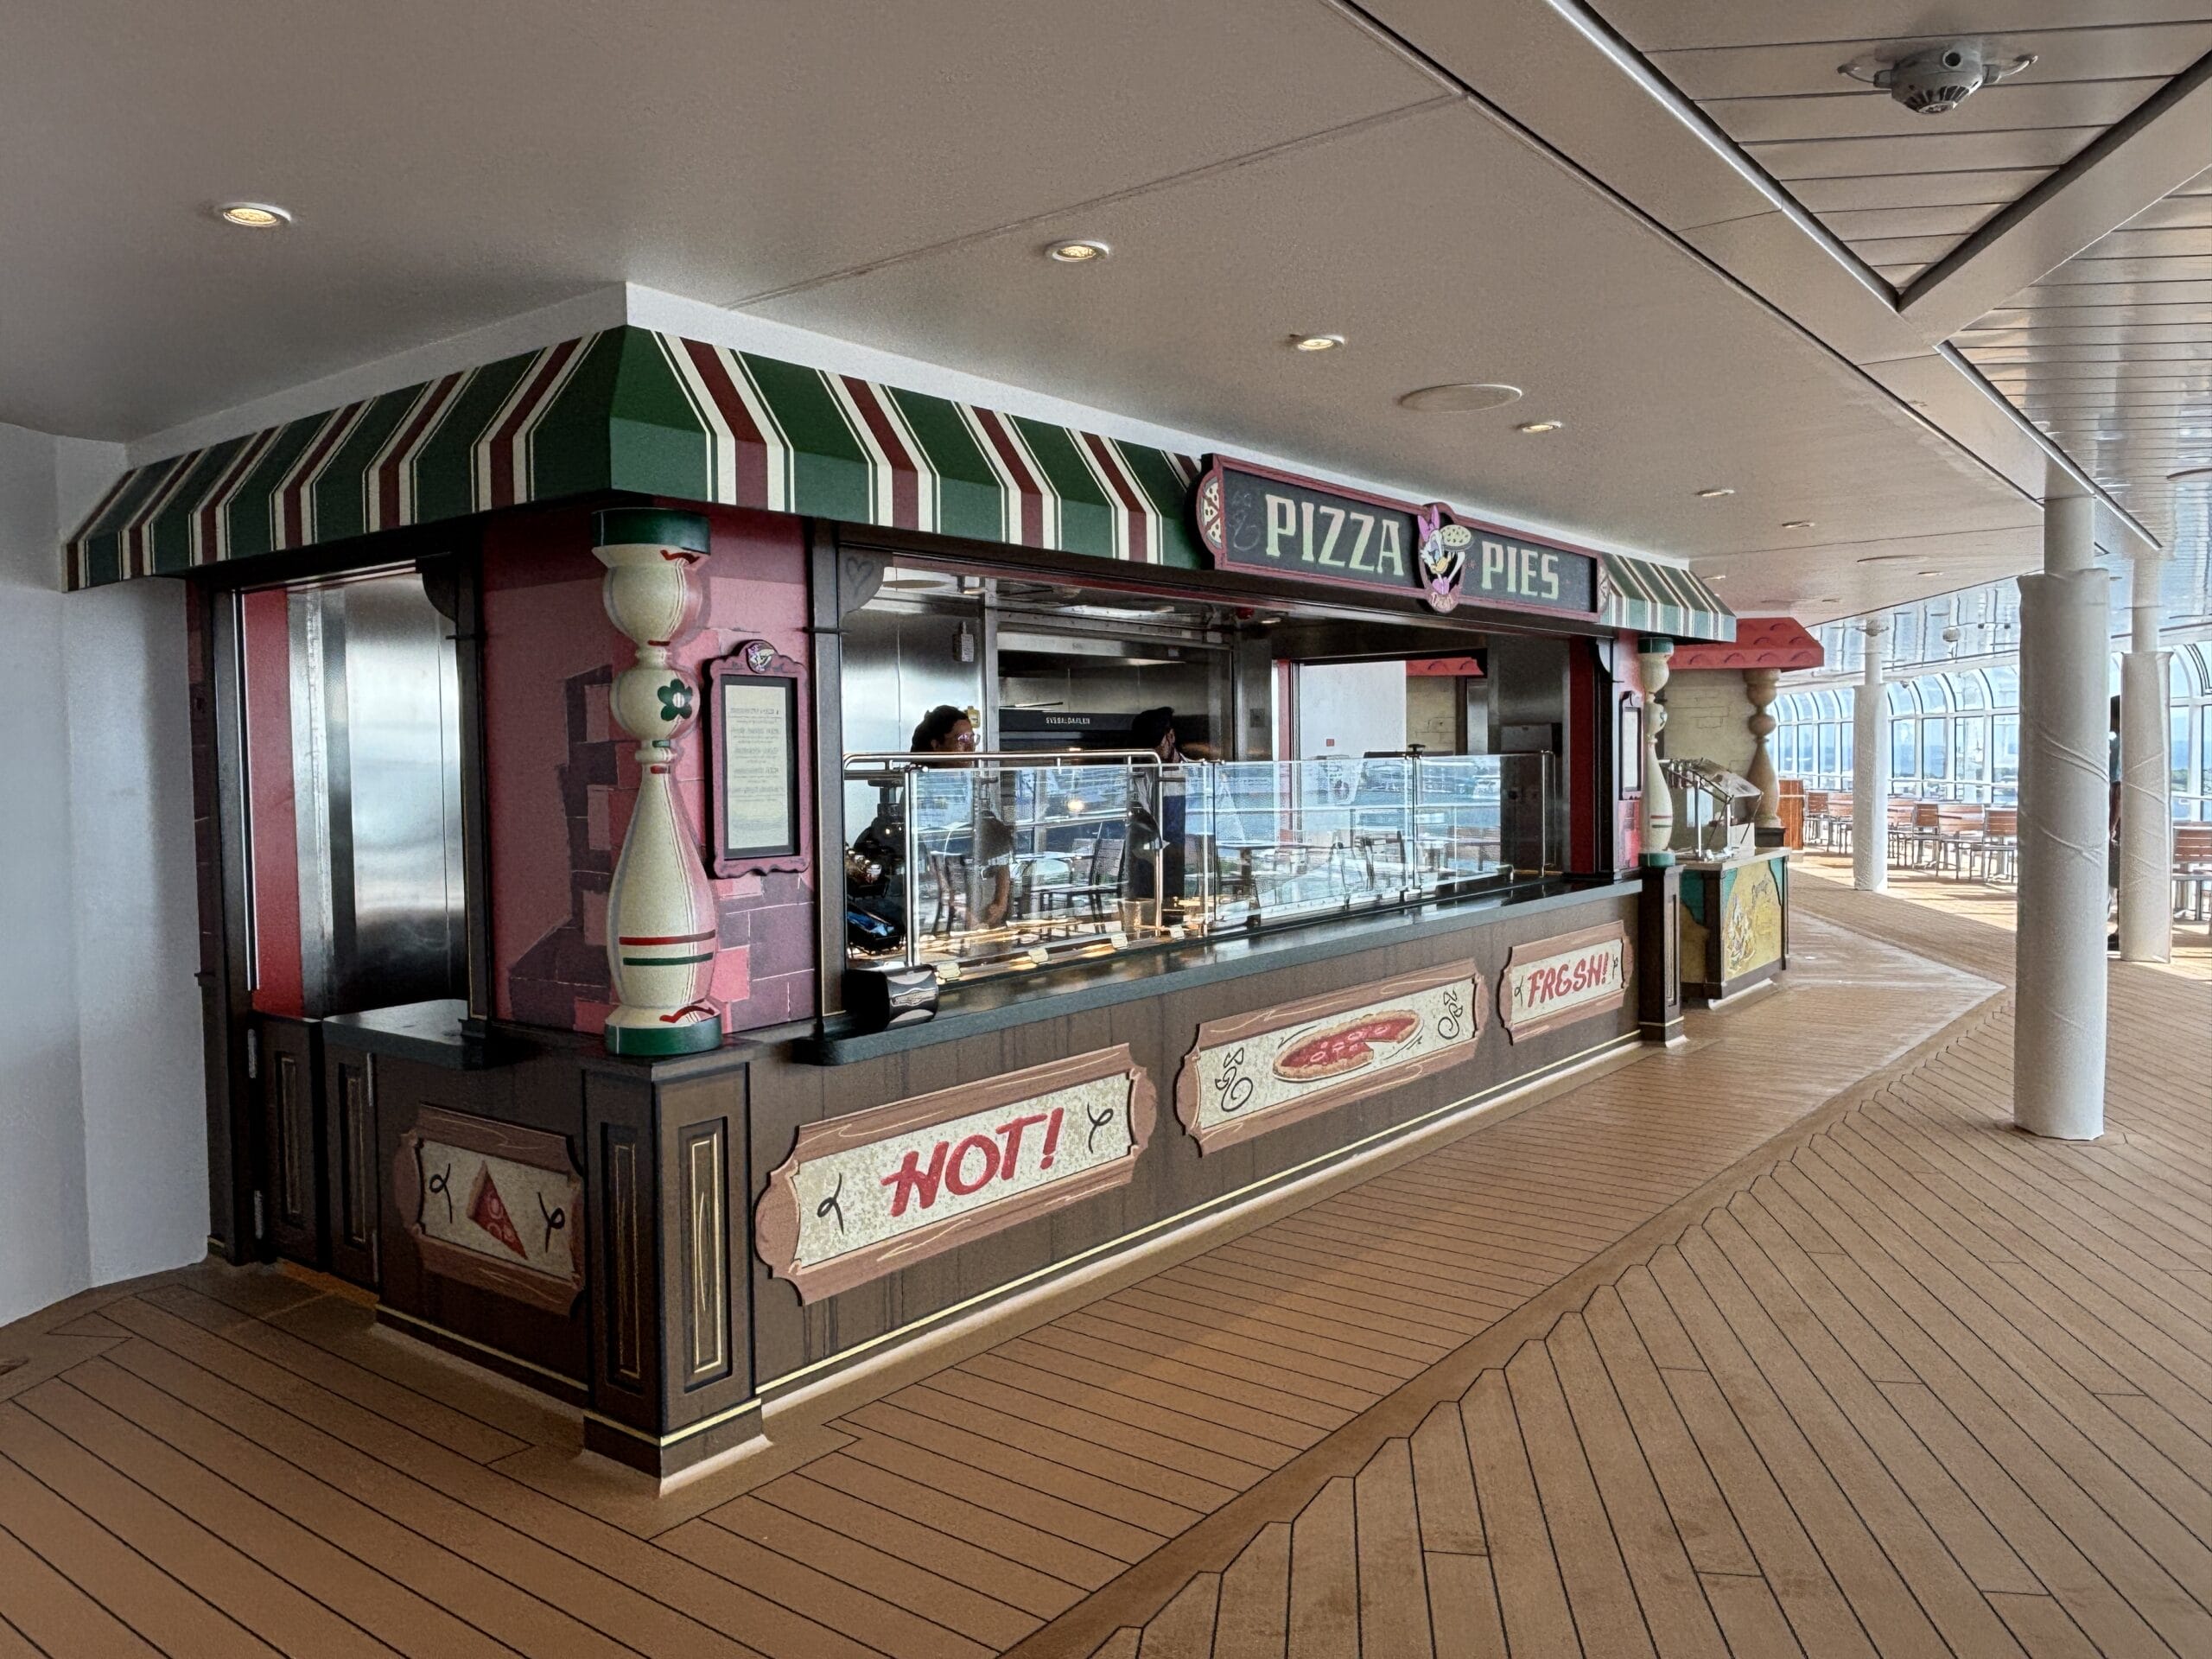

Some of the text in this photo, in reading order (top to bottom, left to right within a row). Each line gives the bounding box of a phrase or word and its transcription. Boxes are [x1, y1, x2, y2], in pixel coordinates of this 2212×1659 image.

[1265, 493, 1560, 599] PIZZA PIES
[1527, 951, 1609, 1007] FRESH!
[880, 1107, 1064, 1217] HOT!
